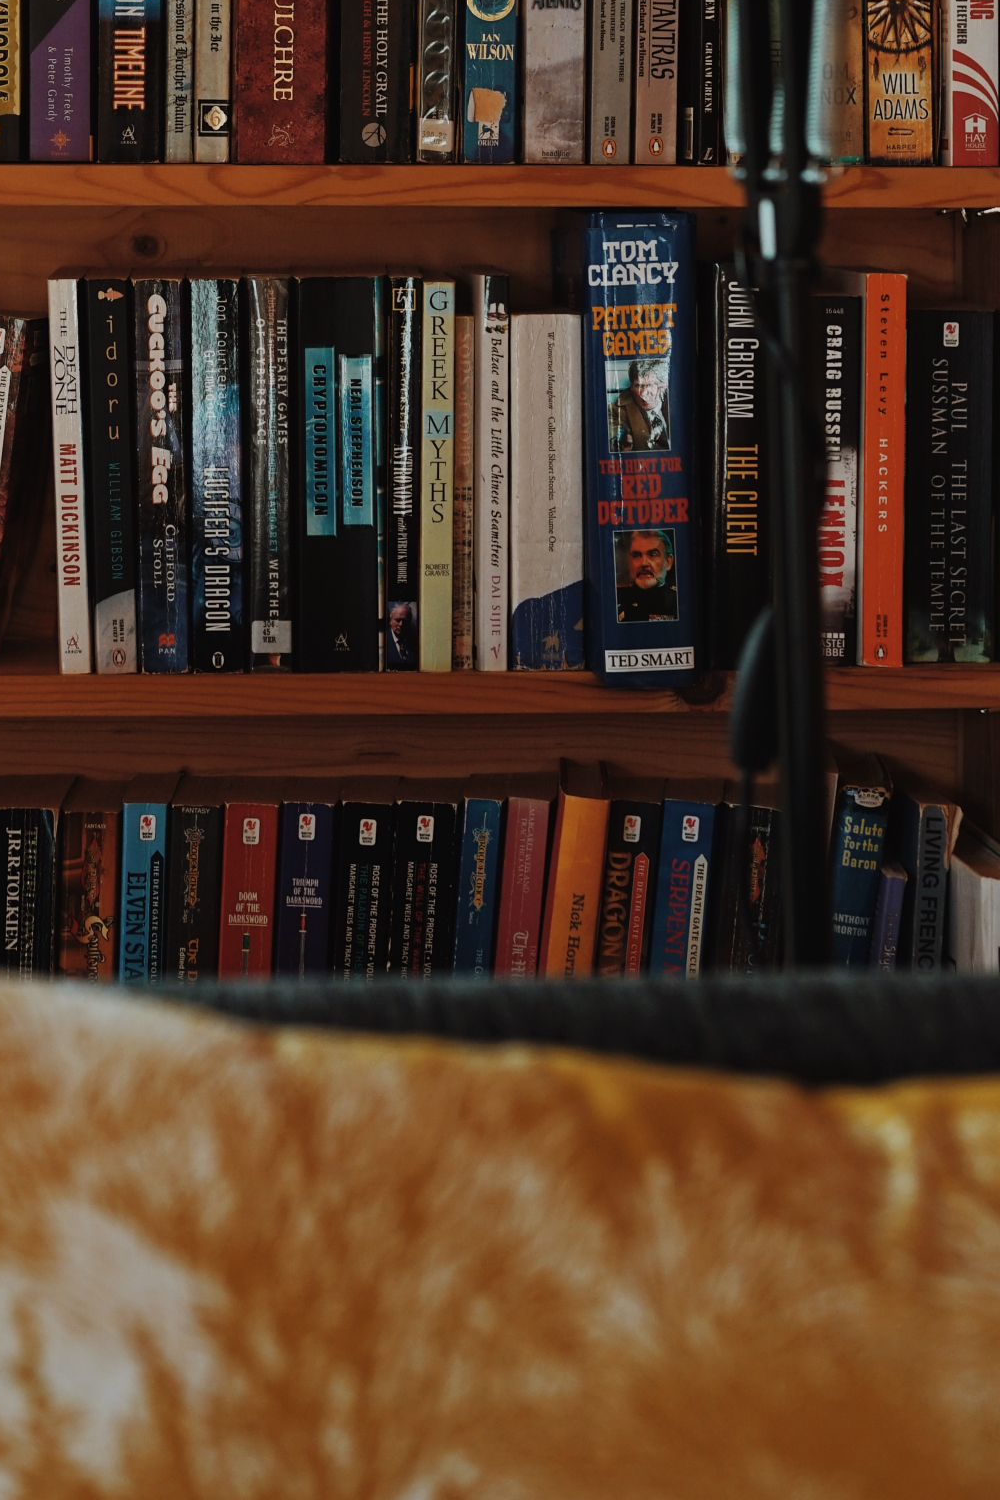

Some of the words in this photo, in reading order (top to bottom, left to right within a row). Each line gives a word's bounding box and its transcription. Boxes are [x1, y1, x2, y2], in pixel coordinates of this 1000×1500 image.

[883, 73, 919, 95] WILL
[873, 98, 929, 120] ADAMS
[602, 241, 658, 263] TOM
[588, 262, 679, 286] CLANCY
[592, 304, 677, 330] PATRIOT
[429, 289, 448, 400] GREEK
[602, 330, 671, 355] GAMES
[350, 379, 363, 416] NEAL
[312, 364, 329, 517] CRYPTONOMICON
[59, 443, 77, 486] MATT
[350, 421, 363, 508] STEPHENSON
[427, 414, 450, 524] MYTHS
[878, 439, 888, 533] HACKERS
[60, 494, 81, 587] DICKINSON
[608, 652, 638, 667] TED
[641, 650, 692, 665] SMART
[833, 913, 870, 926] ANTHONY
[833, 925, 867, 937] MORTON
